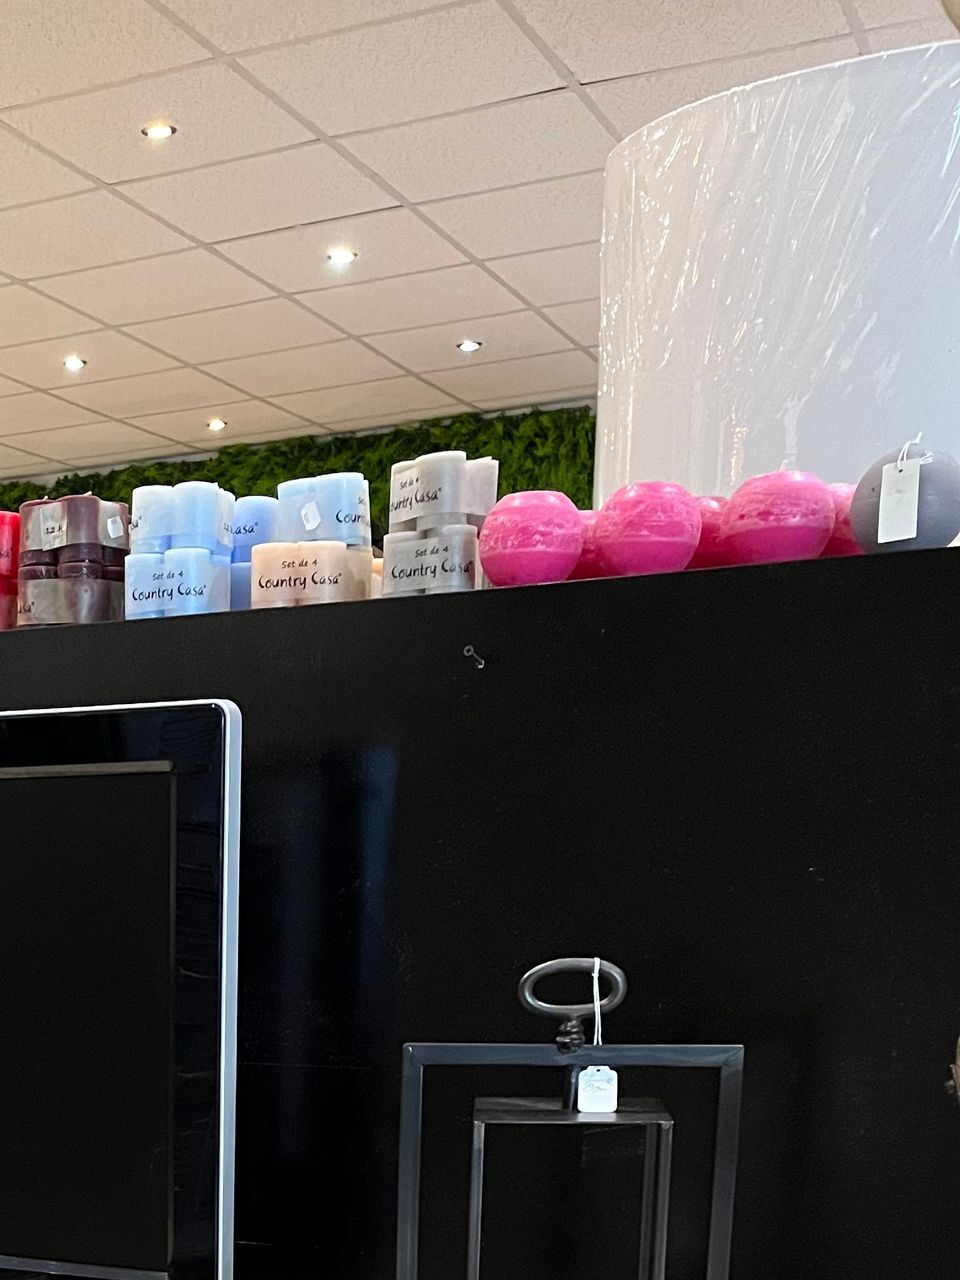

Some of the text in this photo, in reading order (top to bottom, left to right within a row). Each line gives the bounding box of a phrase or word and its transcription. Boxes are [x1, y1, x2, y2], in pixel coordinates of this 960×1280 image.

[390, 489, 439, 512] ountry Casa
[414, 545, 449, 558] Set de 4
[281, 559, 318, 569] Set de 4
[391, 559, 471, 580] Country Casa
[152, 570, 184, 581] Set de 4
[258, 571, 339, 590] Country Casa
[132, 582, 204, 601] Country Casa
